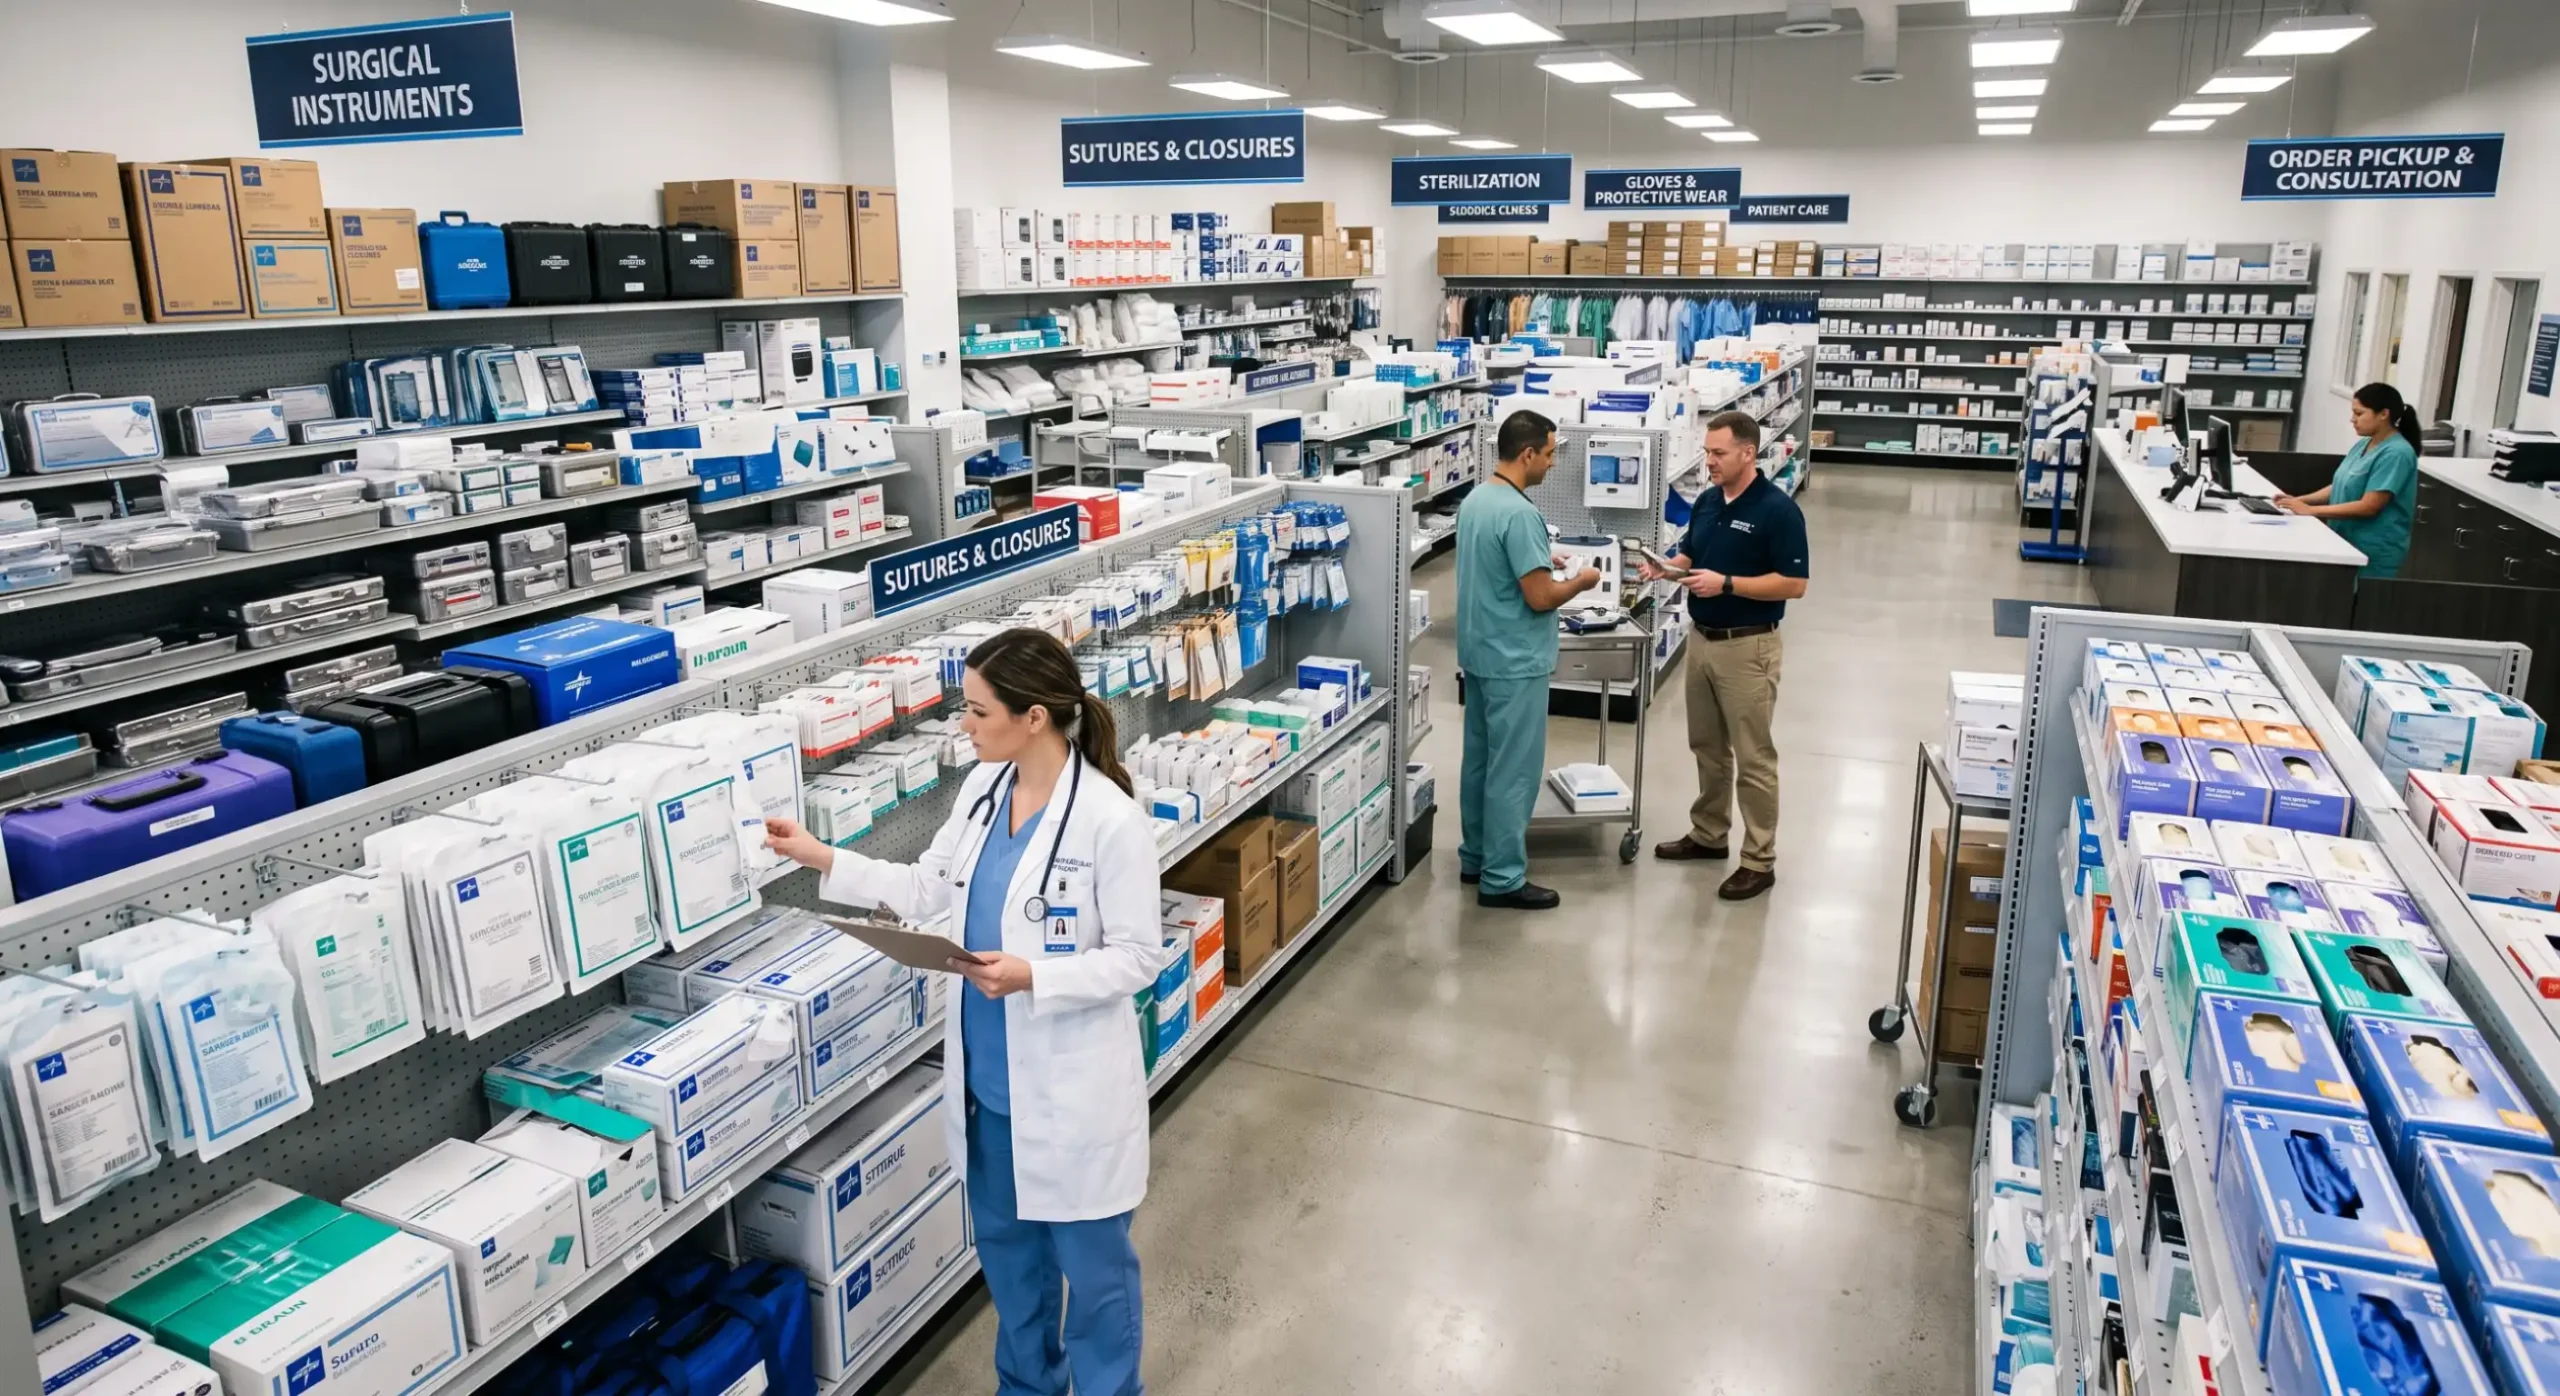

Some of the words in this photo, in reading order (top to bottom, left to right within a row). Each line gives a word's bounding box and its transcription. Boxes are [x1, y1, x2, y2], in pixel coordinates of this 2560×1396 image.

[313, 44, 440, 84] SURGICAL
[292, 83, 473, 126] INSTRUMENTS
[1069, 141, 1160, 164] SUTURES
[1165, 140, 1180, 161] &
[1185, 137, 1295, 160] CLOSURES
[2269, 149, 2352, 169] ORDER
[2358, 147, 2450, 167] PICKUP
[2454, 146, 2475, 165] &
[1419, 172, 1540, 190] STERILIZATION
[1625, 175, 1682, 189] GLOVES
[1685, 175, 1697, 188] &
[2276, 169, 2462, 191] CONSULTATION
[1595, 190, 1682, 204] PROTECTIVE
[1684, 190, 1728, 203] WEAR
[1748, 204, 1795, 216] PATIENT
[1798, 204, 1829, 216] CARE
[884, 548, 969, 595] SUTURES
[973, 543, 988, 568] &
[990, 517, 1071, 561] CLOSURES
